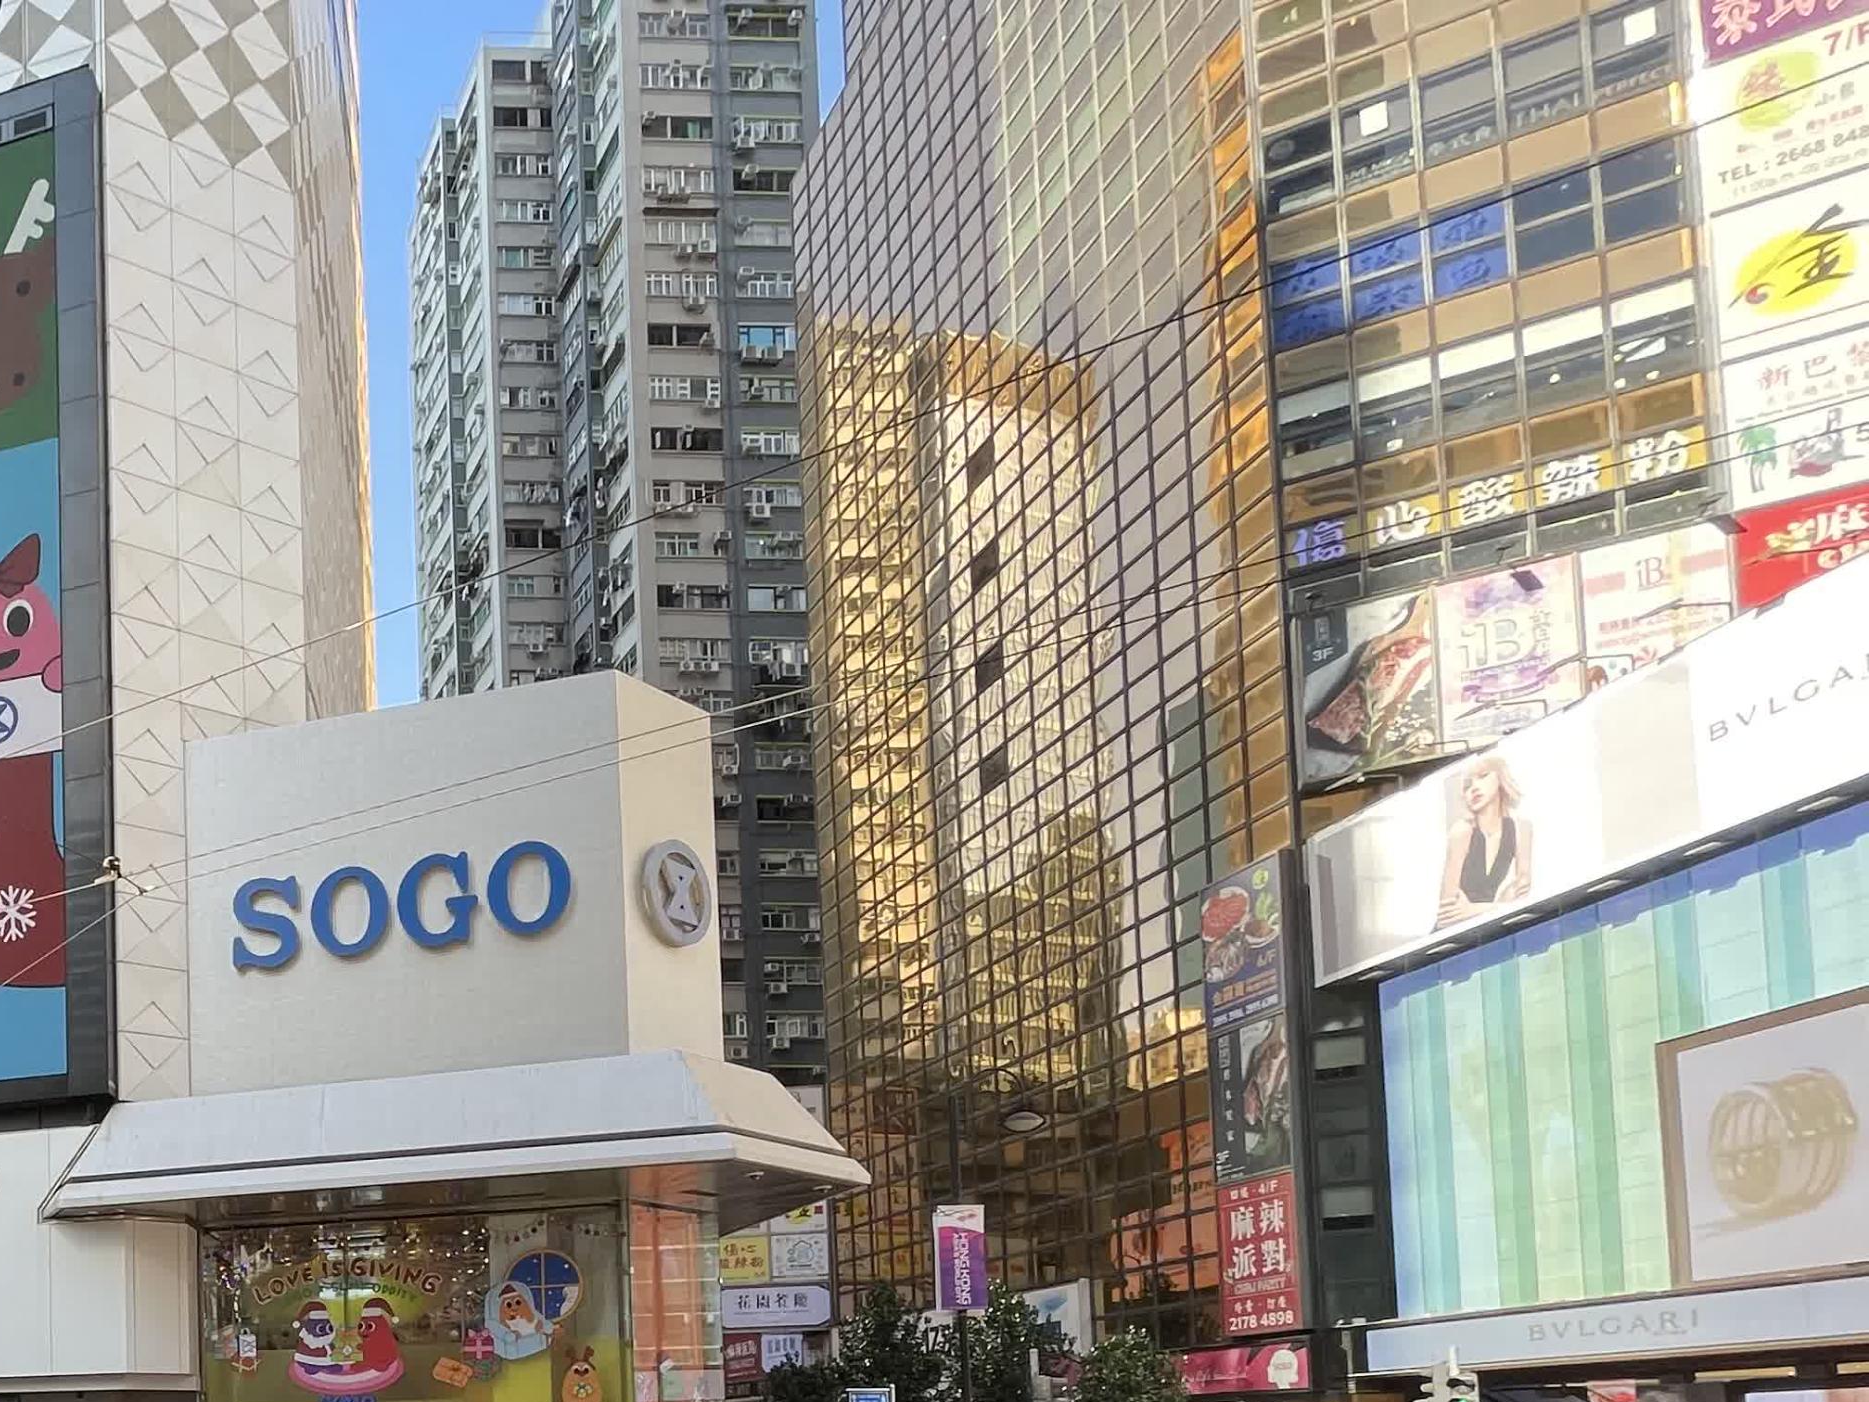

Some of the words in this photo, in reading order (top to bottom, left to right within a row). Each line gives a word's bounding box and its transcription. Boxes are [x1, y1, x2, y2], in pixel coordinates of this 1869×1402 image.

[1513, 93, 1583, 129] THAI
[1718, 162, 1757, 185] TEL
[1776, 138, 1827, 167] 2668
[1635, 556, 1667, 590] iB
[1312, 646, 1334, 662] 3F
[1709, 653, 1869, 742] BVLGA
[232, 840, 572, 974] SOGO
[1230, 1199, 1286, 1241] 麻辣
[959, 1232, 971, 1268] HONG
[1232, 1238, 1287, 1279] 派對
[252, 1265, 315, 1306] LOVE
[321, 1260, 343, 1278] IS
[349, 1256, 443, 1296] GIVING
[960, 1269, 972, 1305] KONG
[1229, 1315, 1257, 1331] 2178
[1528, 1308, 1699, 1342] BVLGARI
